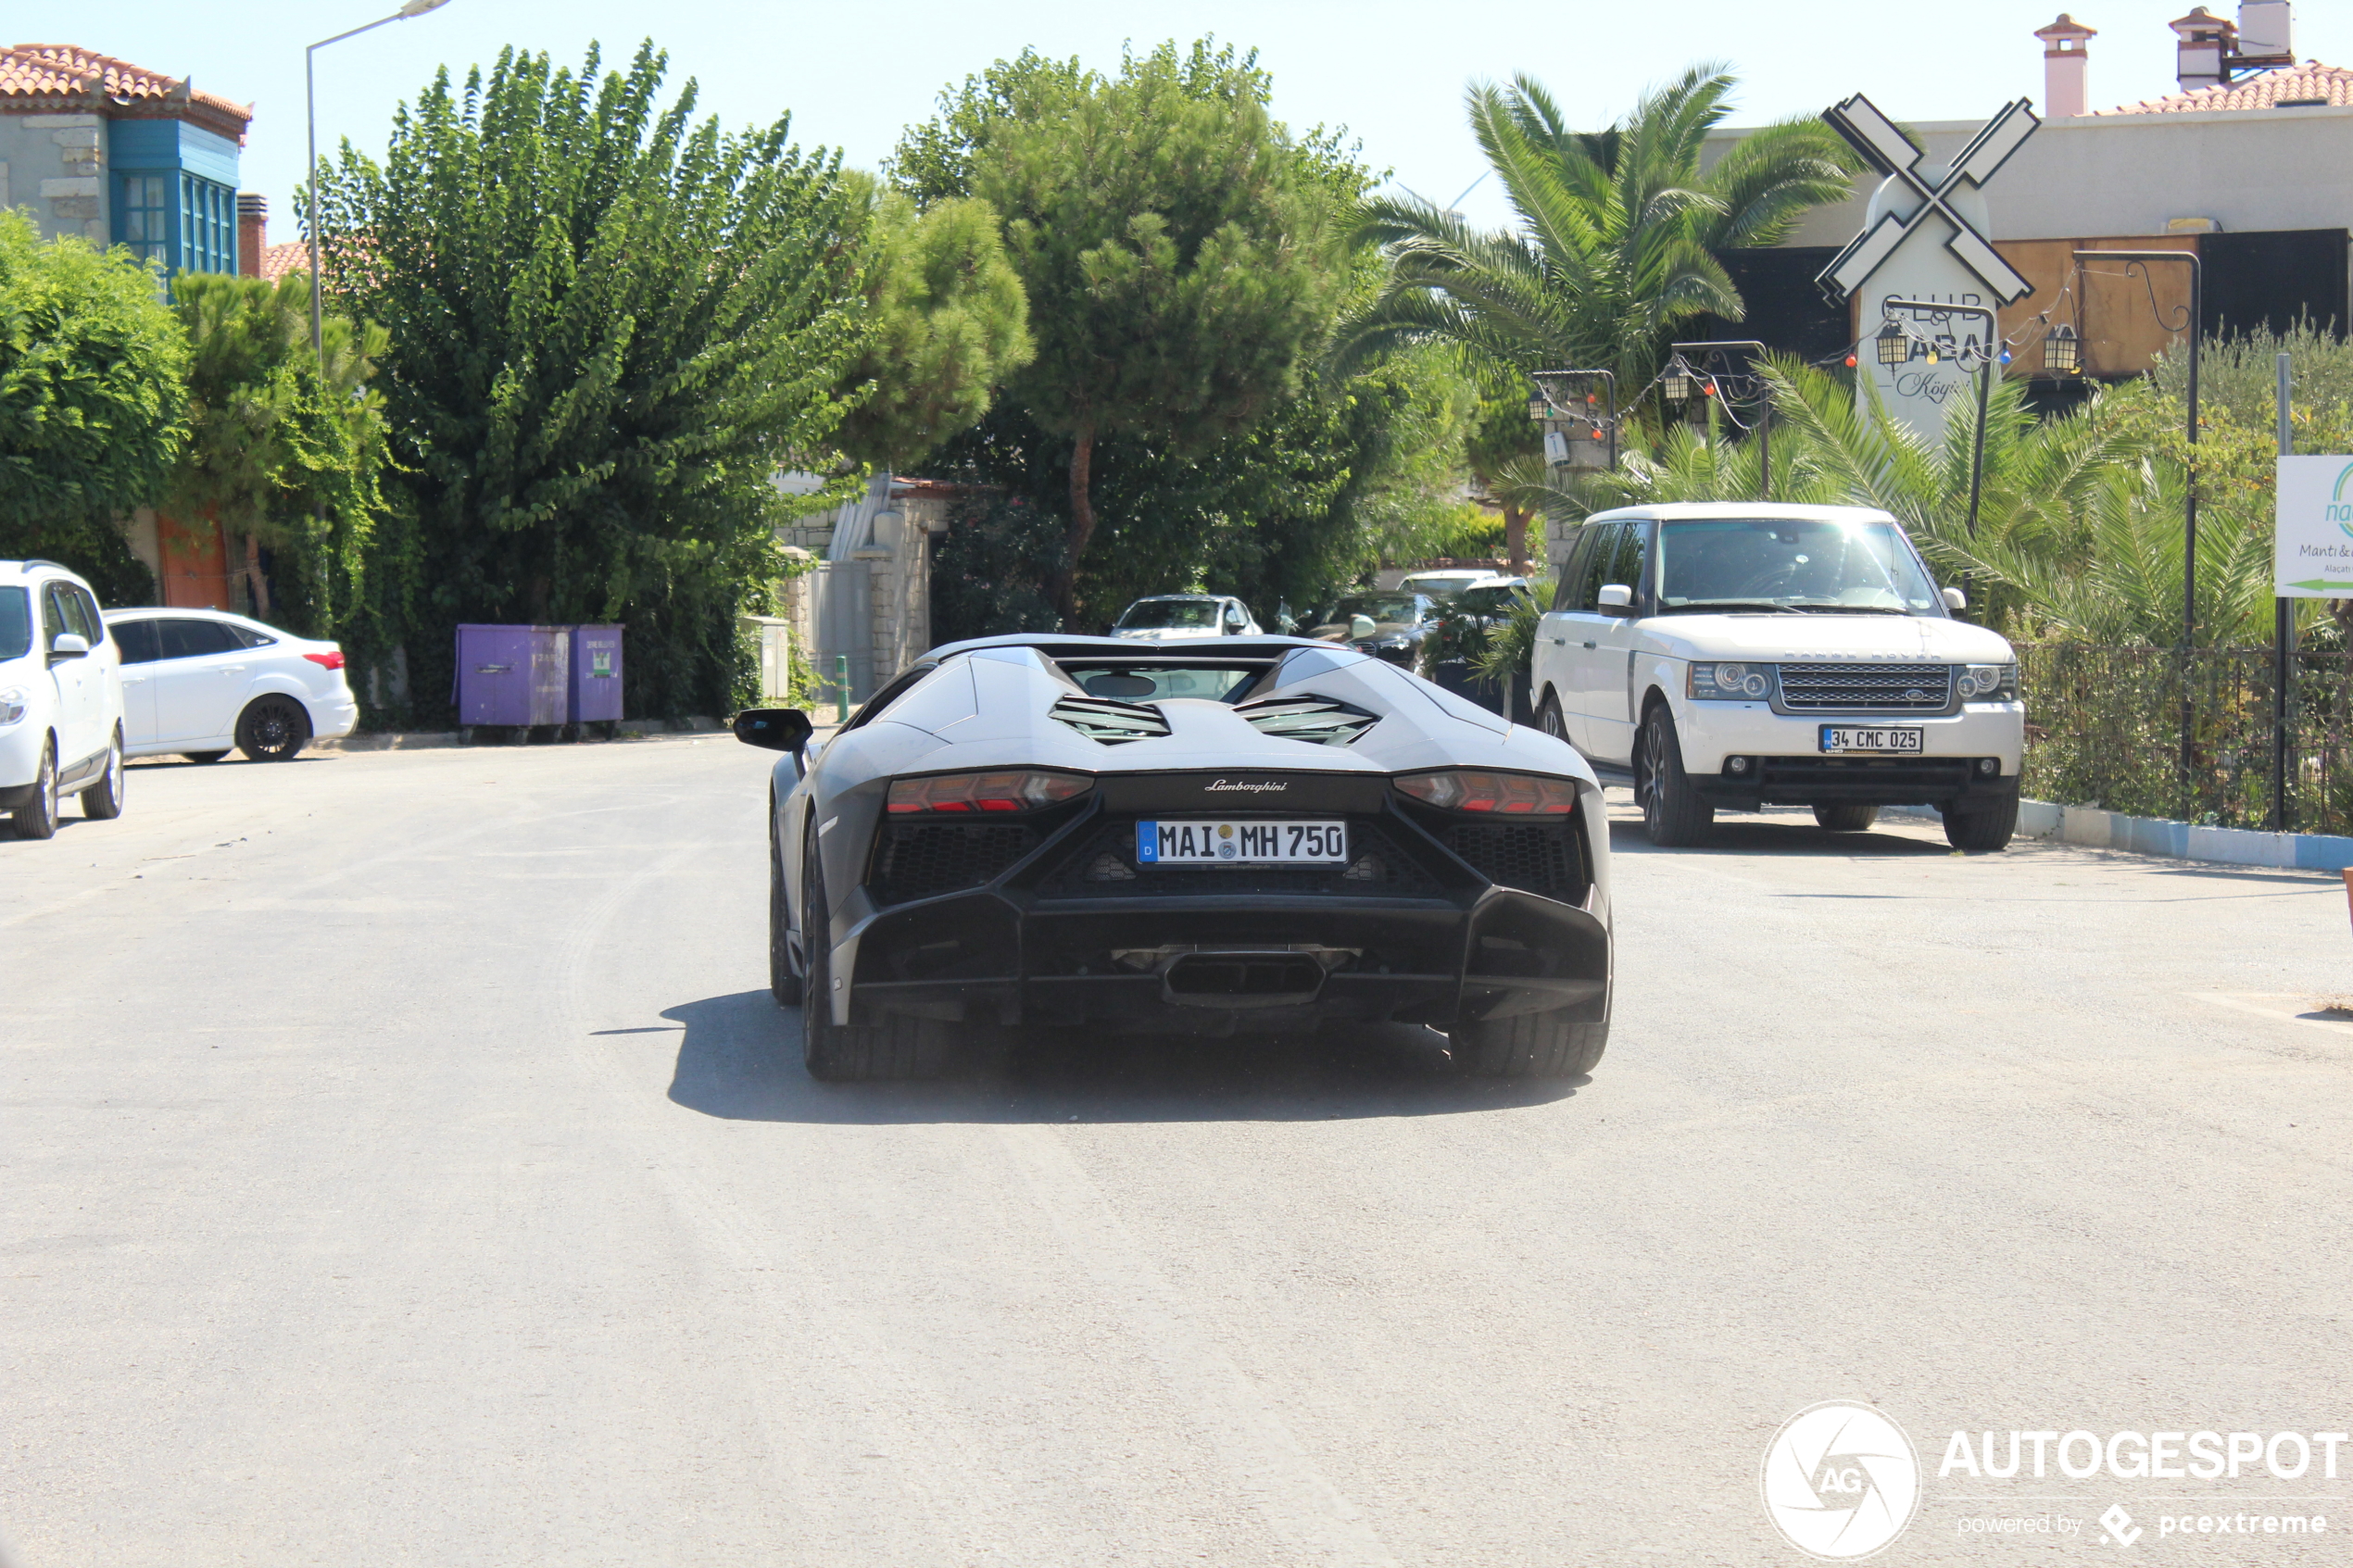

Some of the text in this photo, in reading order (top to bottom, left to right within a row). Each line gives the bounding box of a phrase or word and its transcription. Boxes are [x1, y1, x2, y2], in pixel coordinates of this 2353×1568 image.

[1881, 294, 1982, 321] CLUB
[2325, 504, 2353, 521] na
[2299, 544, 2337, 558] Mantı
[2339, 545, 2350, 558] &
[1784, 649, 1942, 660] RANGE ROVER
[1831, 731, 1917, 748] 34 CMC 025
[1204, 779, 1288, 794] Lamborghini
[1158, 825, 1343, 857] MAI MH 750
[1144, 847, 1152, 856] D
